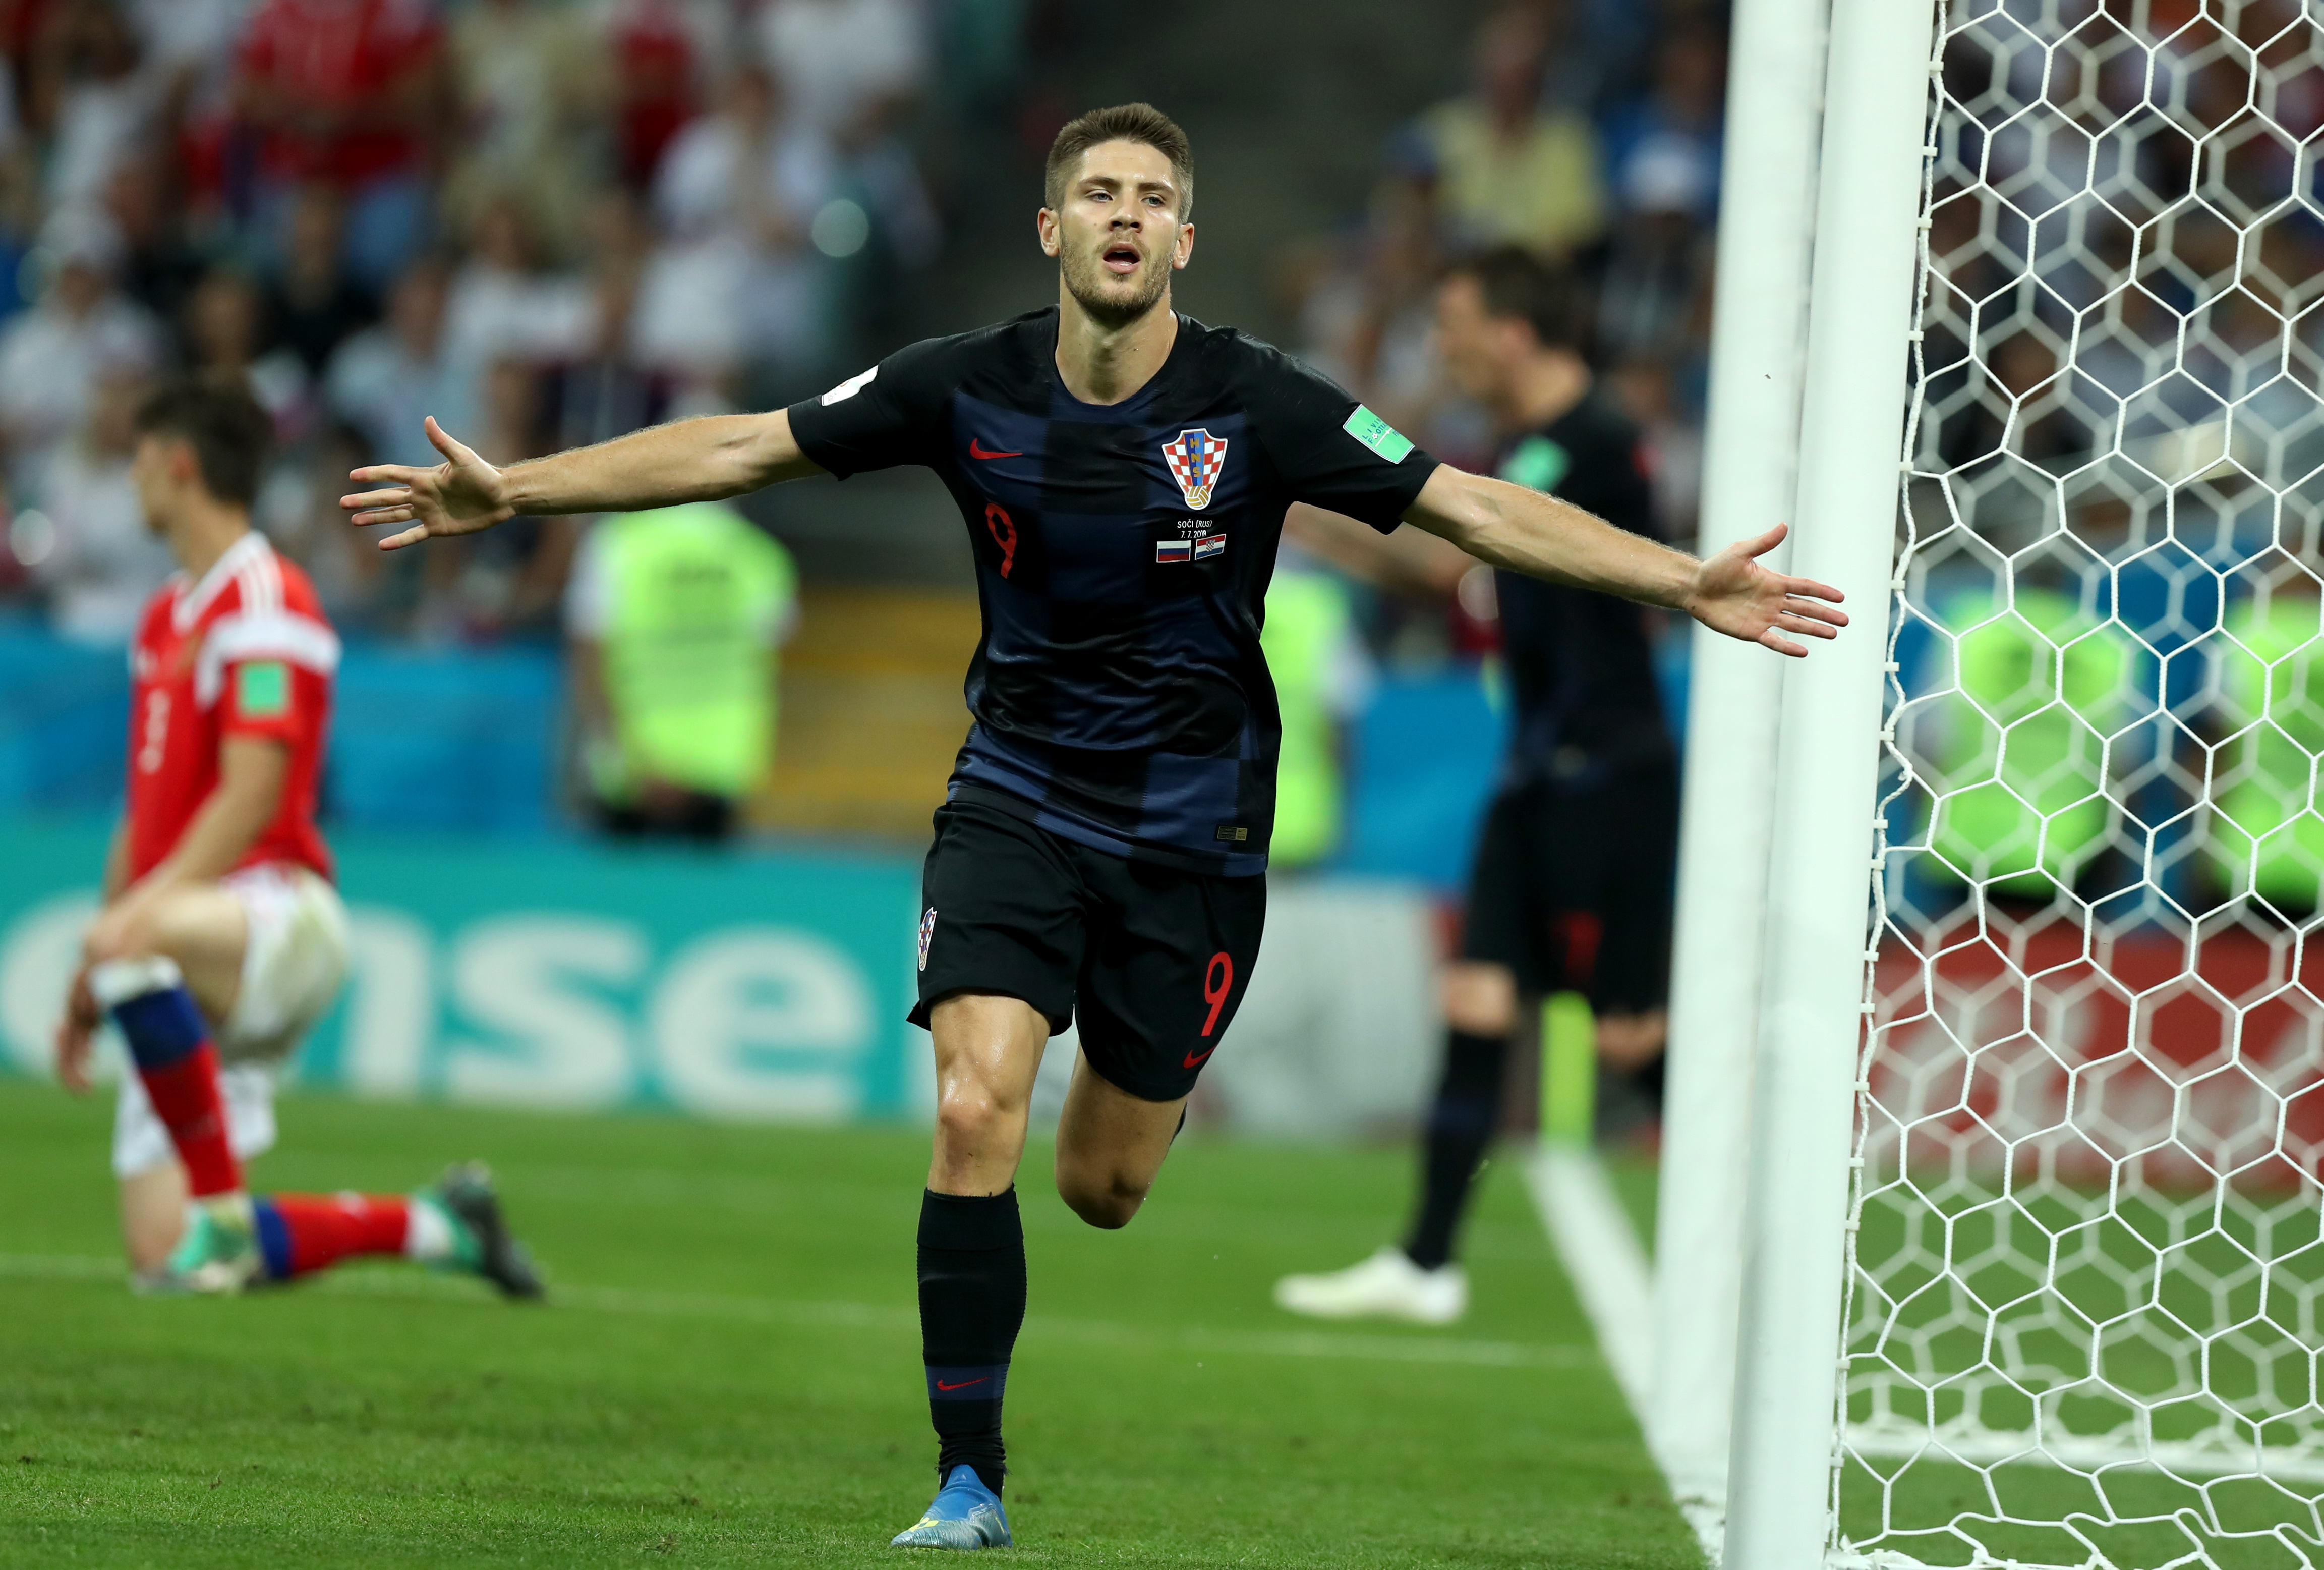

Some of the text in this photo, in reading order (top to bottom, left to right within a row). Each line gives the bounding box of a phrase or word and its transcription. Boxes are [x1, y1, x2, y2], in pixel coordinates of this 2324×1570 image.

[1189, 438, 1200, 477] HNS
[985, 503, 1017, 579] 9
[1177, 519, 1212, 528] SOČI (RUS)
[1204, 951, 1233, 1036] 9
